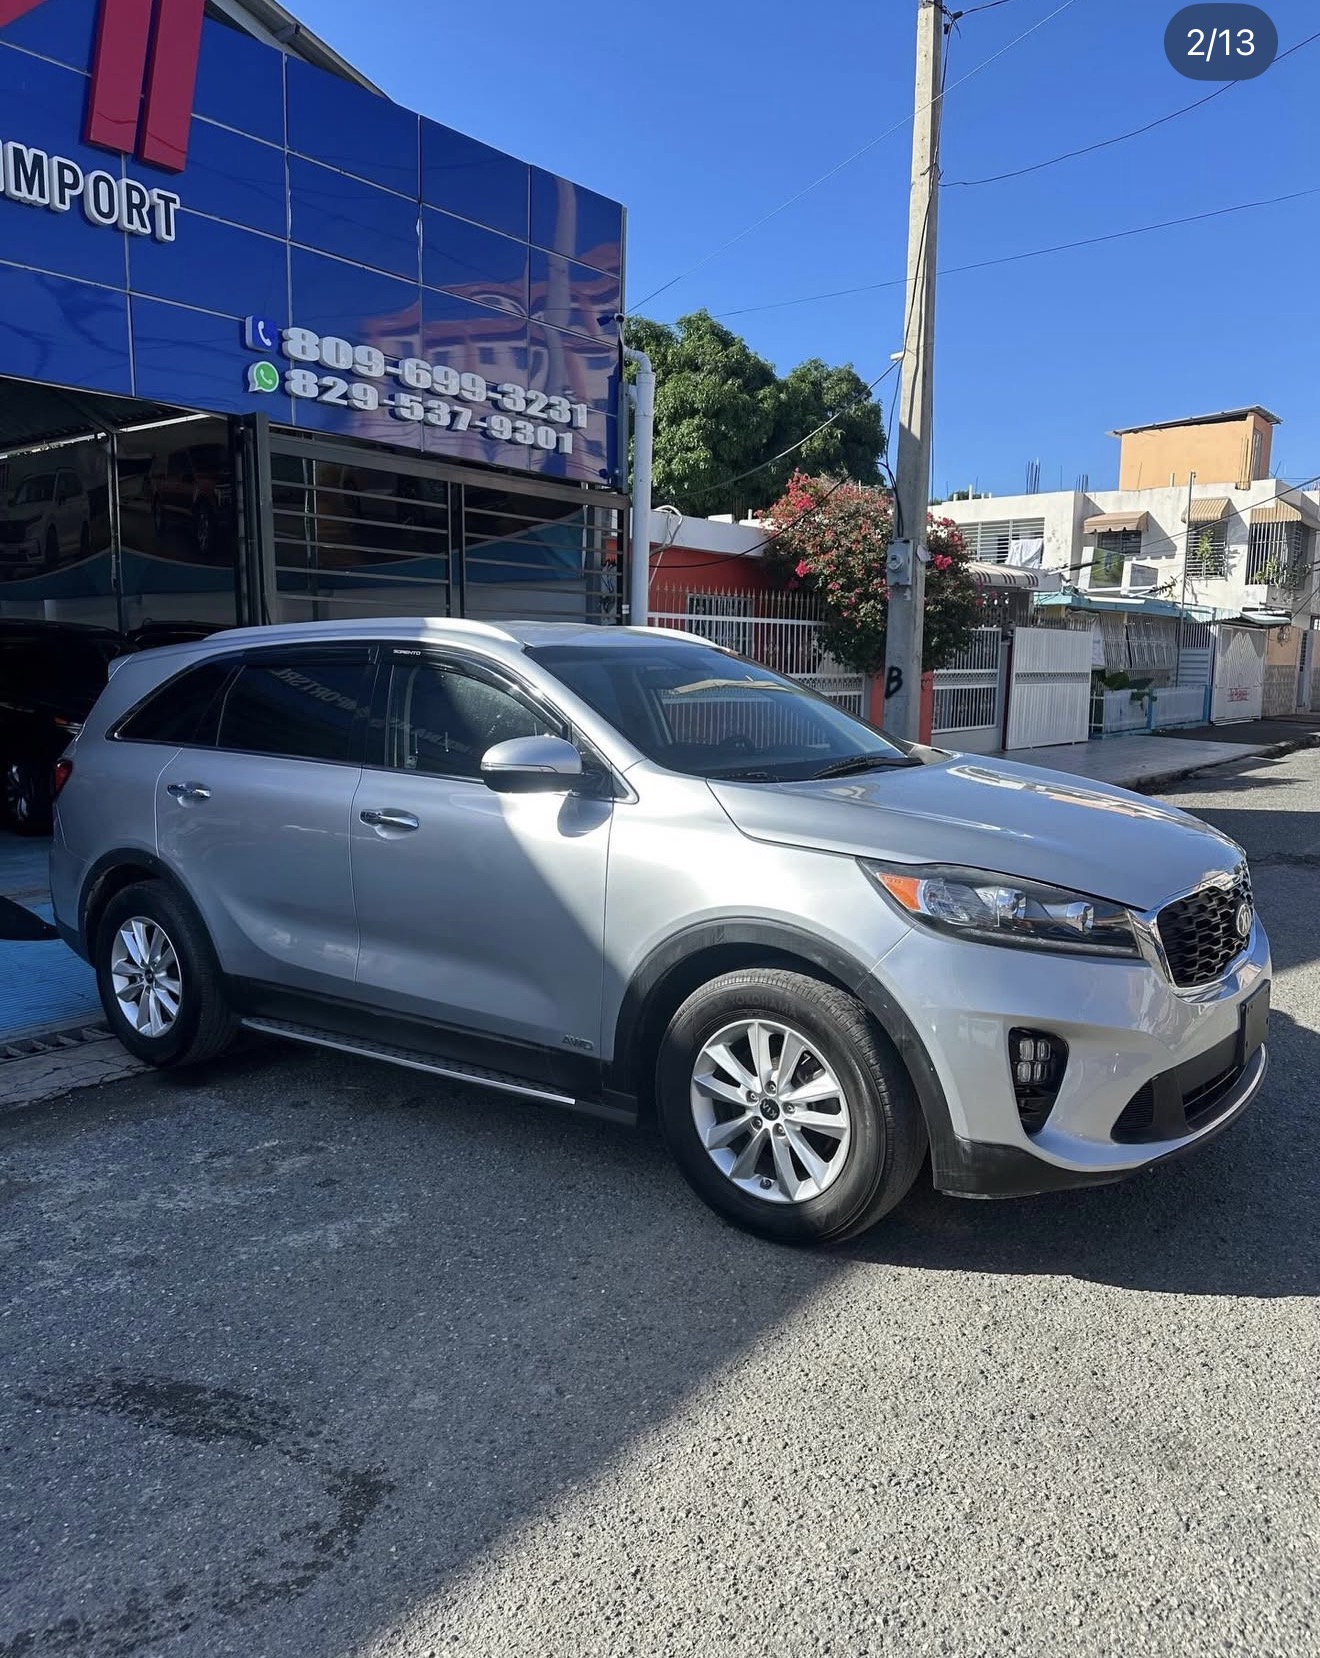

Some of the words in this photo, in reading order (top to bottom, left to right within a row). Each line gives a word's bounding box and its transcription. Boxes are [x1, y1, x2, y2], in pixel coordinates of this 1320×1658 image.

[0, 139, 181, 242] MPORT
[282, 327, 588, 429] 809-699-3231
[285, 368, 573, 454] 829-537-9301
[885, 665, 903, 700] B
[561, 1034, 593, 1051] AWD
